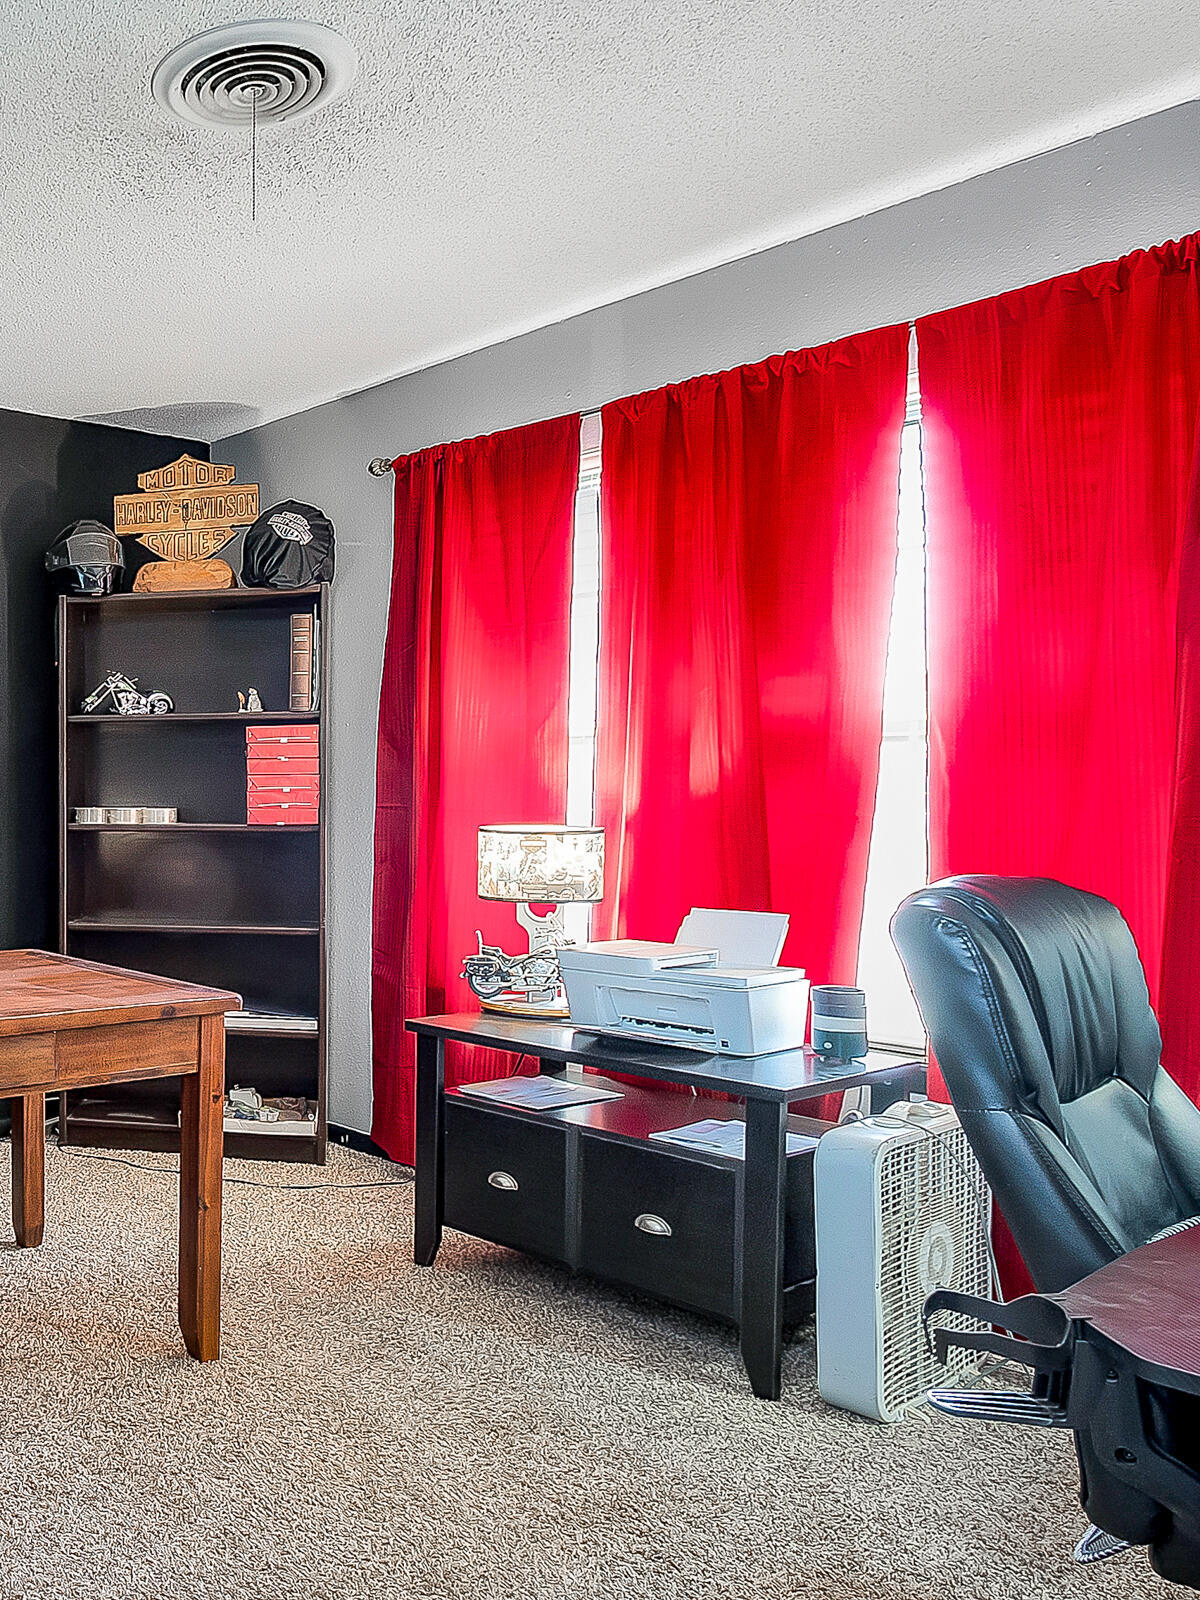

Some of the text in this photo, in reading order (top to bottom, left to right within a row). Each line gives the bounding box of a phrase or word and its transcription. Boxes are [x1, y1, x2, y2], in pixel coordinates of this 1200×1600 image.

[146, 459, 228, 489] MOTOR
[116, 493, 258, 526] HARLEY-DAVIDSON
[147, 530, 227, 562] CYCLES
